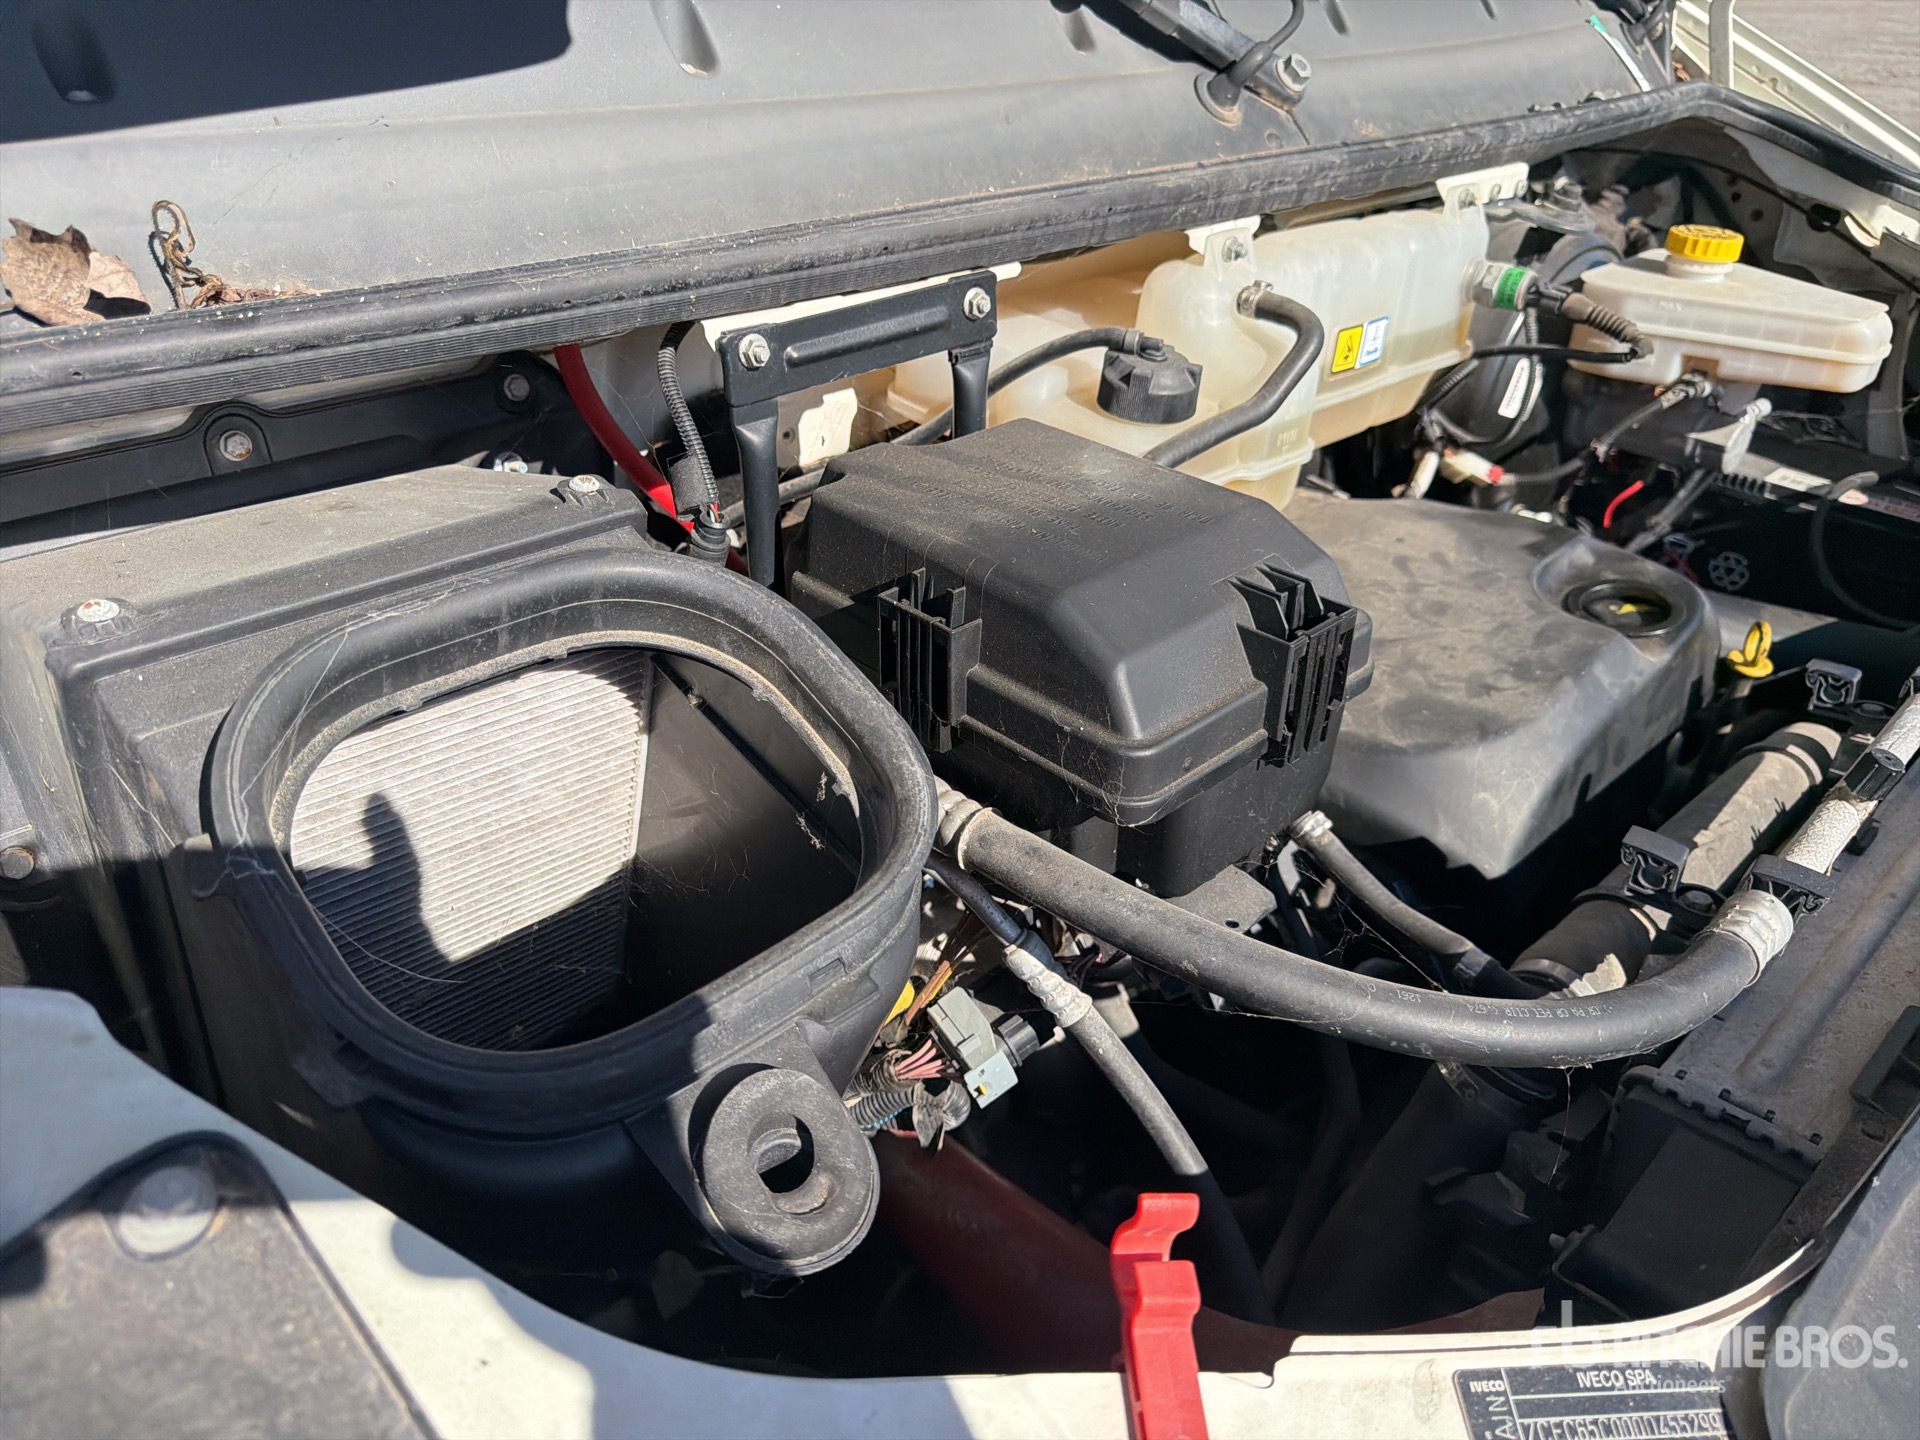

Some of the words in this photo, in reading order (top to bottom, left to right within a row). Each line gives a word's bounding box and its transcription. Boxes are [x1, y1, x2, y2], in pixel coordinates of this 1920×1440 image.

[1276, 428, 1298, 447] MIN
[1469, 1380, 1506, 1392] IVECO
[1575, 1370, 1624, 1388] IVECO
[1625, 1369, 1657, 1386] SPA
